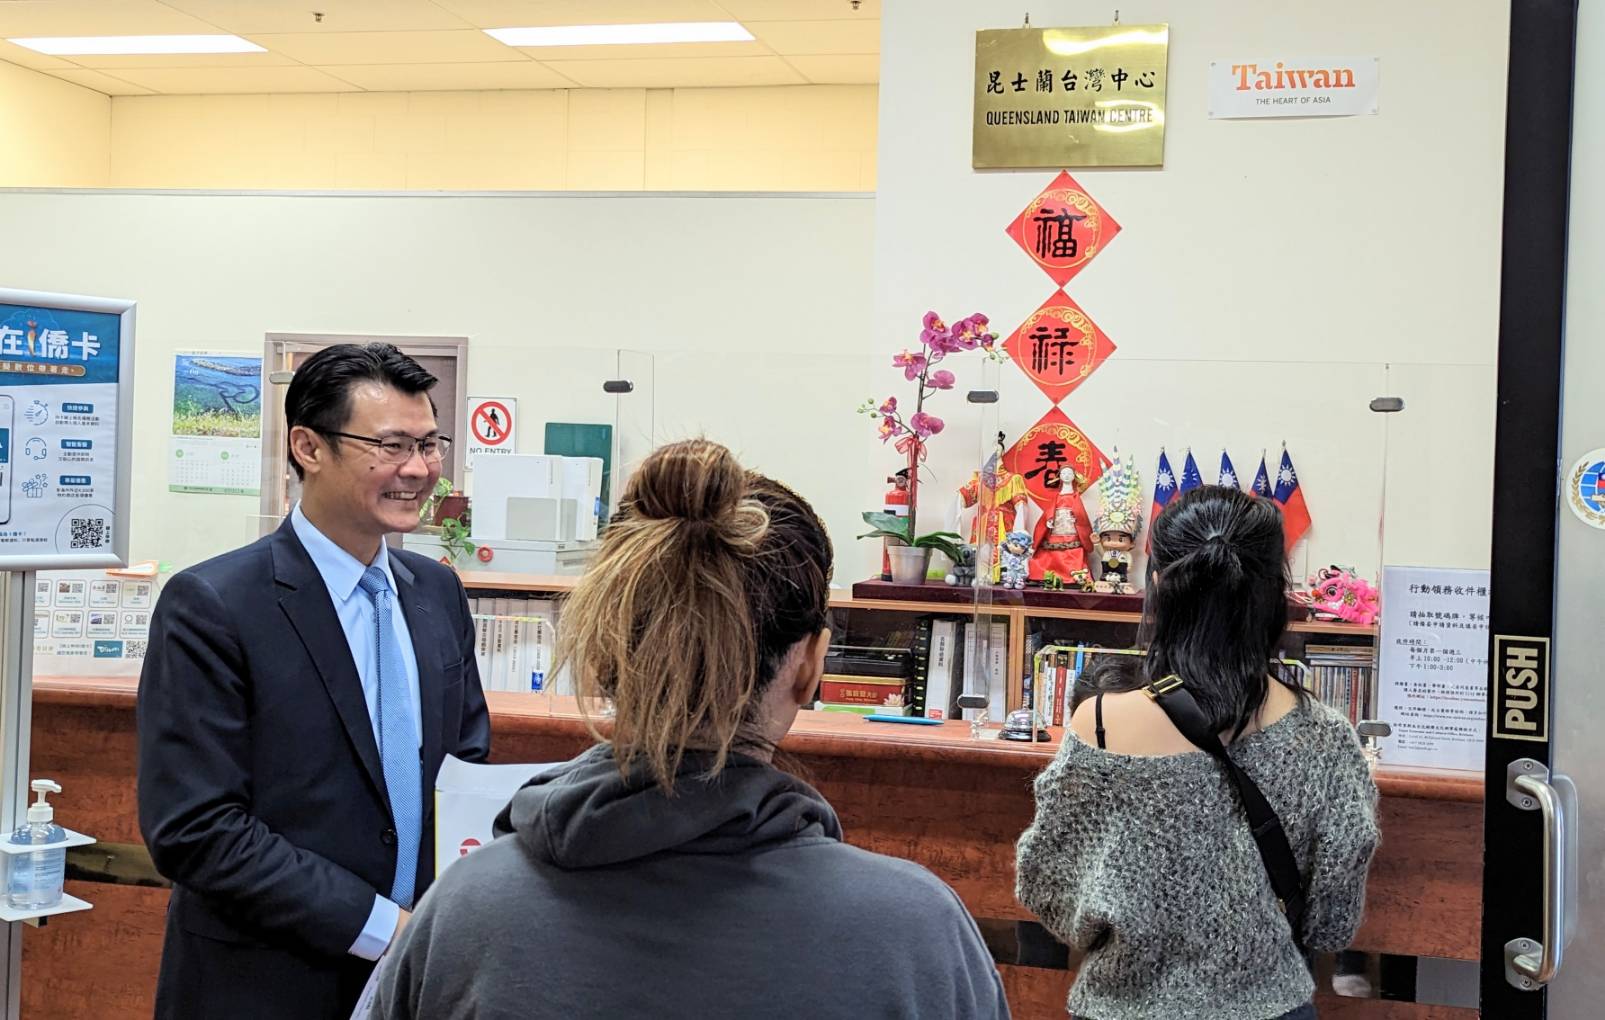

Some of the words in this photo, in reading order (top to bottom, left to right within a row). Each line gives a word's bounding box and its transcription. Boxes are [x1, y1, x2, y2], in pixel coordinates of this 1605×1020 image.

[987, 68, 1156, 94] 昆士蘭台灣中心
[1231, 62, 1356, 91] Taiwan
[1273, 97, 1299, 105] HEART
[1313, 96, 1331, 104] ASIA
[986, 110, 1060, 125] QUEENSLAND
[1064, 109, 1106, 125] TAIWAN
[1109, 108, 1153, 123] CENTRE
[1033, 208, 1087, 258] 福
[1408, 584, 1490, 596] 行動領務收件櫃
[1504, 646, 1539, 731] PUSH
